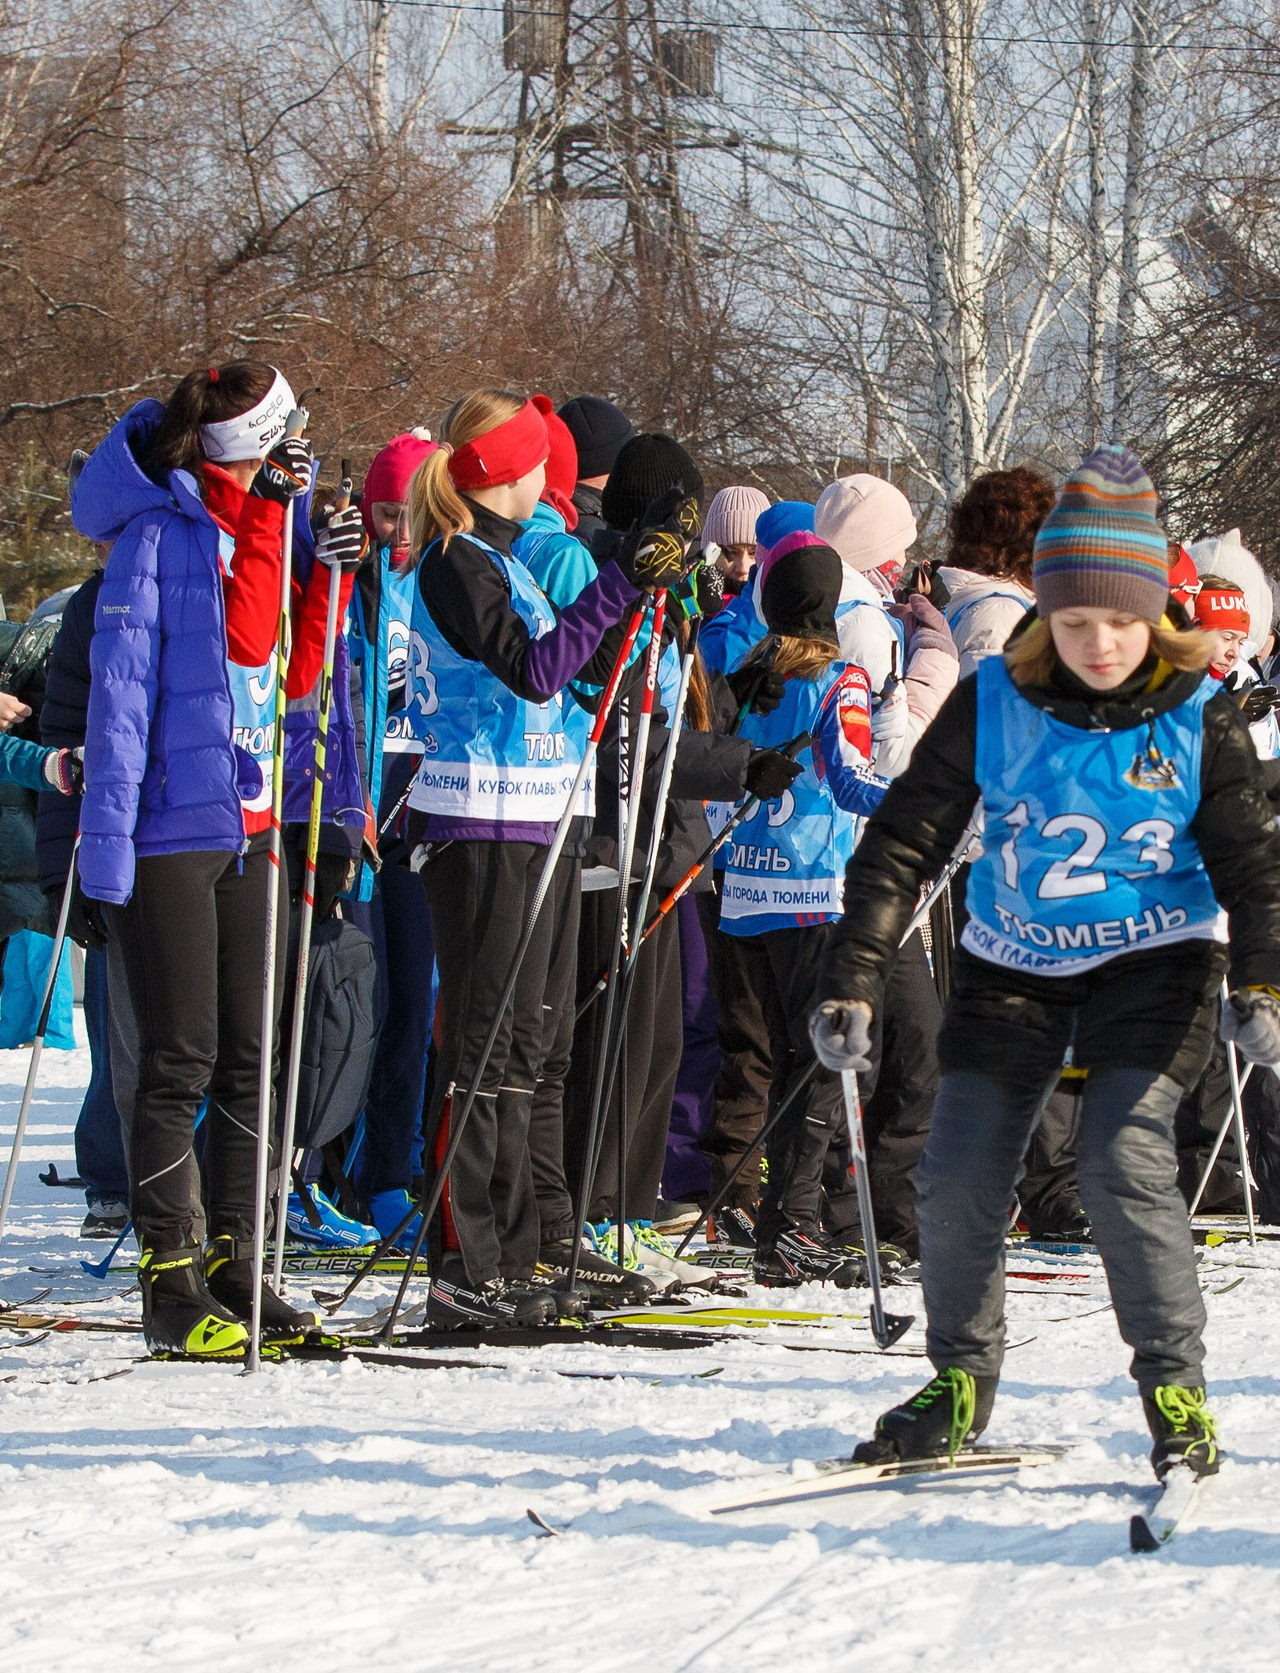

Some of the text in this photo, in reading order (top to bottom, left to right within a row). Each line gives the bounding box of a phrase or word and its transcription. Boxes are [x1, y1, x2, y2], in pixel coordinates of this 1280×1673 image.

[102, 605, 131, 616] Marmot
[478, 779, 522, 796] КУБОК
[727, 841, 791, 873] МЕНЬ
[1001, 800, 1176, 899] 123
[772, 890, 830, 905] ТЮМЕНИ
[994, 902, 1188, 951] ТЮМЕНЬ
[282, 1258, 363, 1271] ISCHER
[775, 1241, 831, 1270] SPINE
[435, 1278, 518, 1316] SPINE
